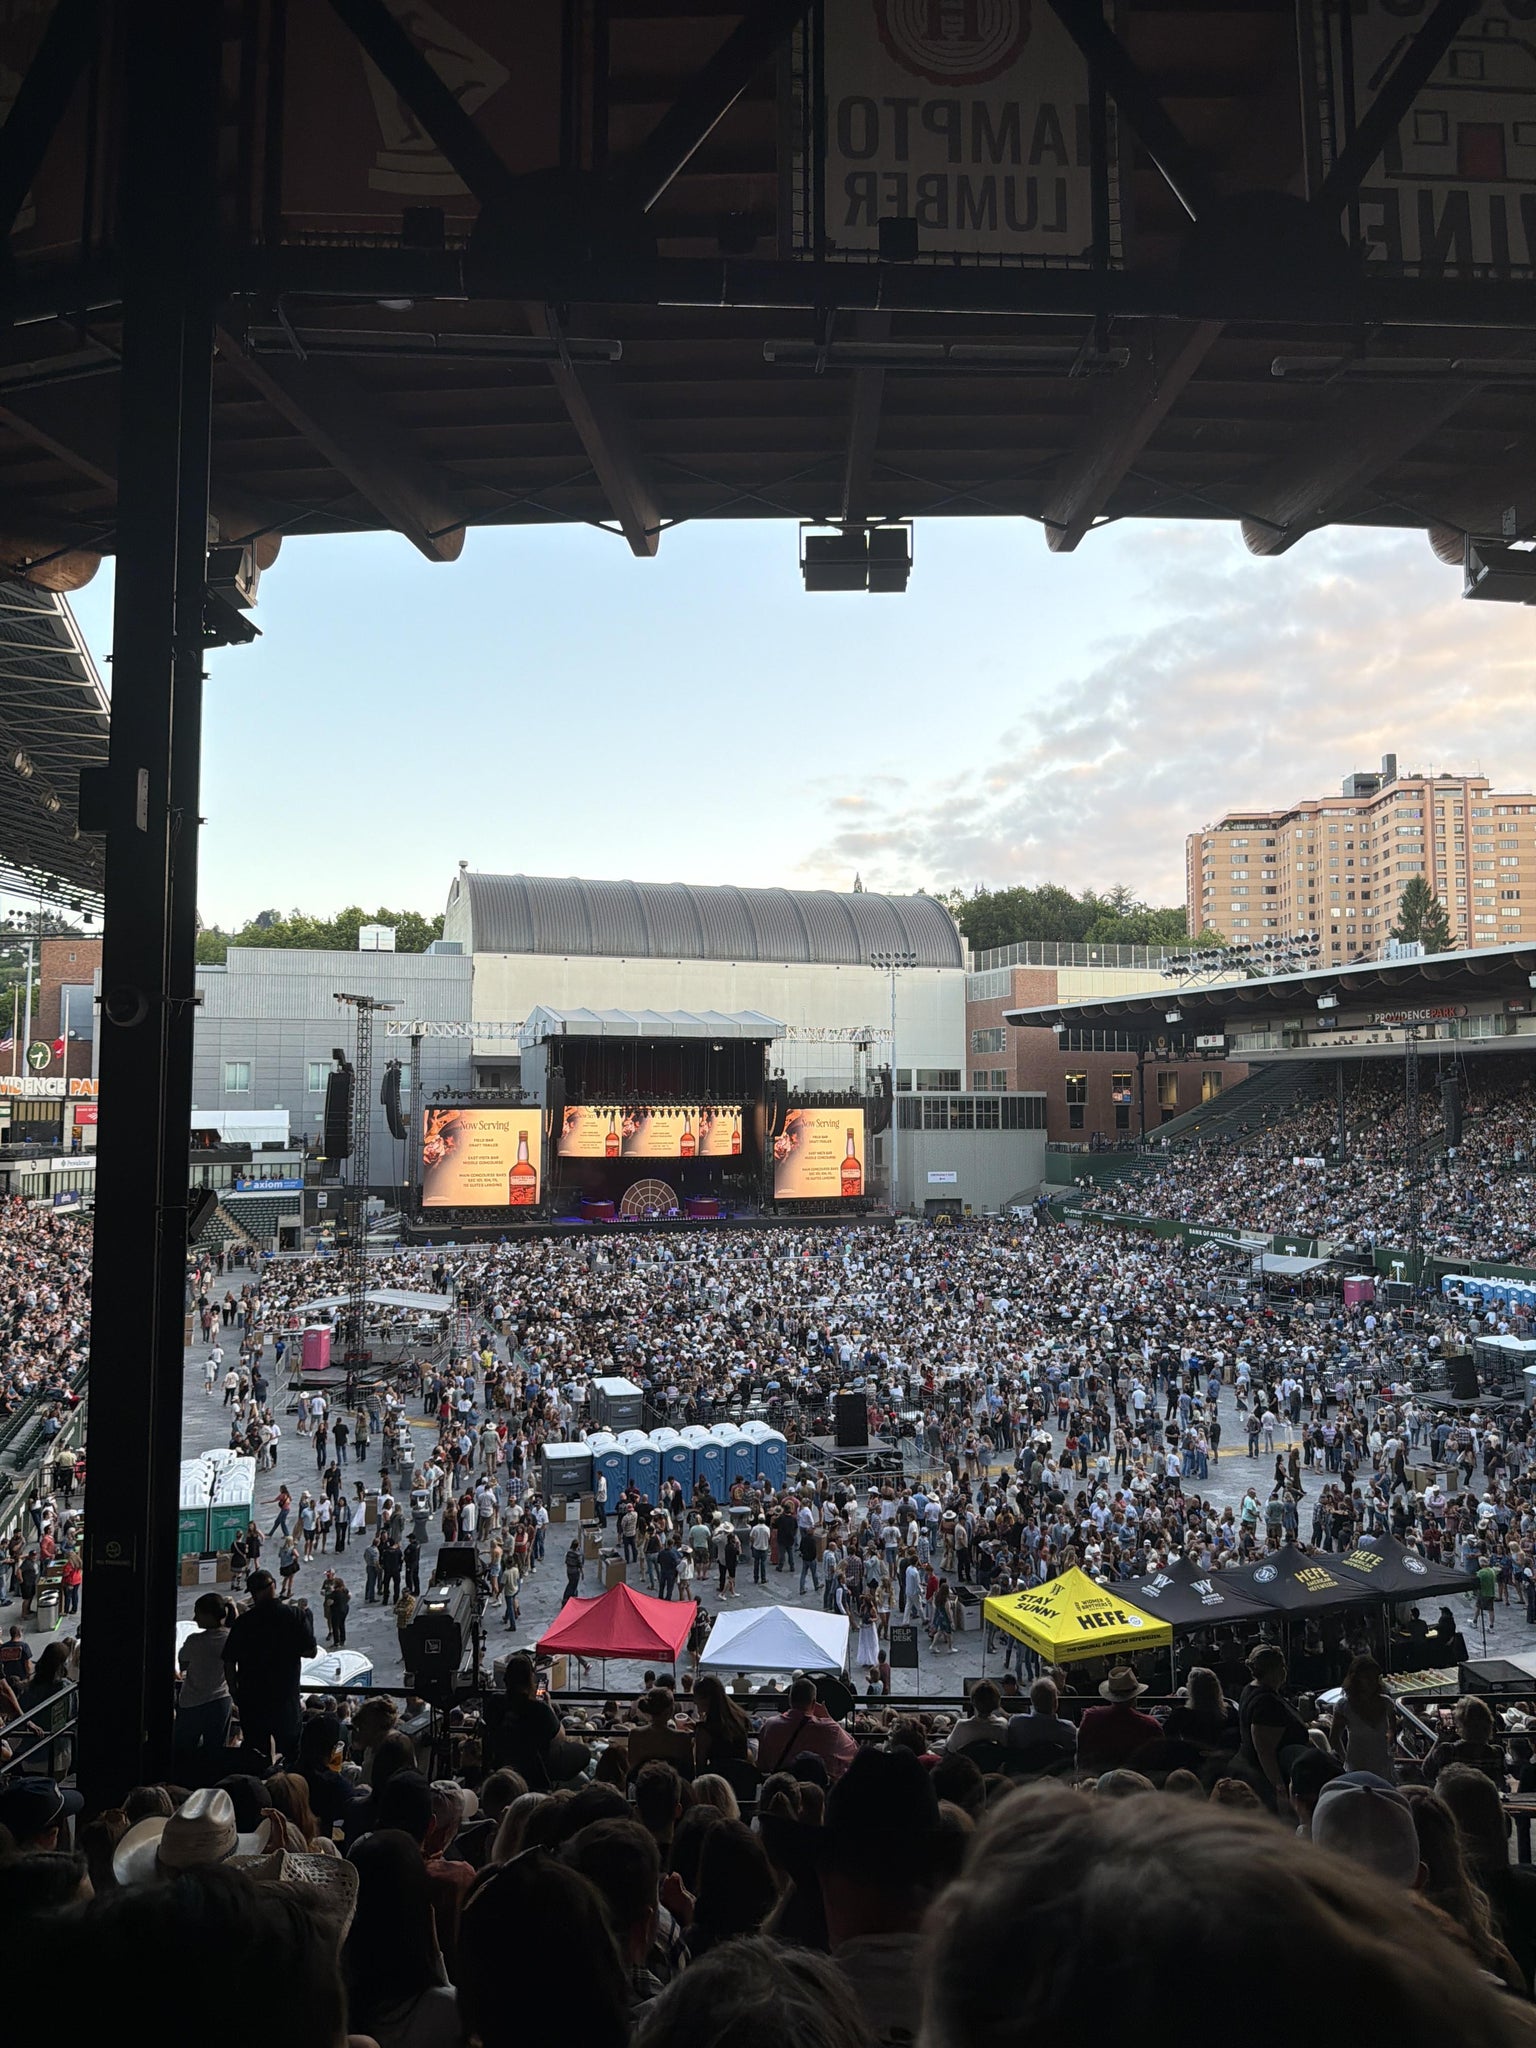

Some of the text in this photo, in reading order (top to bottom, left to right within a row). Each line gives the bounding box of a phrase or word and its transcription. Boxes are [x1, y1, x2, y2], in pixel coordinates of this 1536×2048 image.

[460, 1120, 510, 1132] Now Serving
[802, 1118, 840, 1130] Now Serving
[253, 1180, 283, 1189] axiom
[1188, 1228, 1202, 1236] BANK
[1210, 1231, 1233, 1240] AMERICA
[1350, 1549, 1384, 1566] HEFE
[1152, 1573, 1175, 1588] W
[1293, 1567, 1330, 1583] HEFE
[1189, 1579, 1214, 1595] W
[1306, 1577, 1332, 1587] AMERICAN
[1050, 1583, 1066, 1596] W
[1017, 1594, 1055, 1607] STAY
[1014, 1602, 1061, 1619] SUNNY
[1076, 1610, 1130, 1630] HEFE
[1077, 1644, 1101, 1652] ORIGINAL
[1102, 1639, 1129, 1648] AMERICAN
